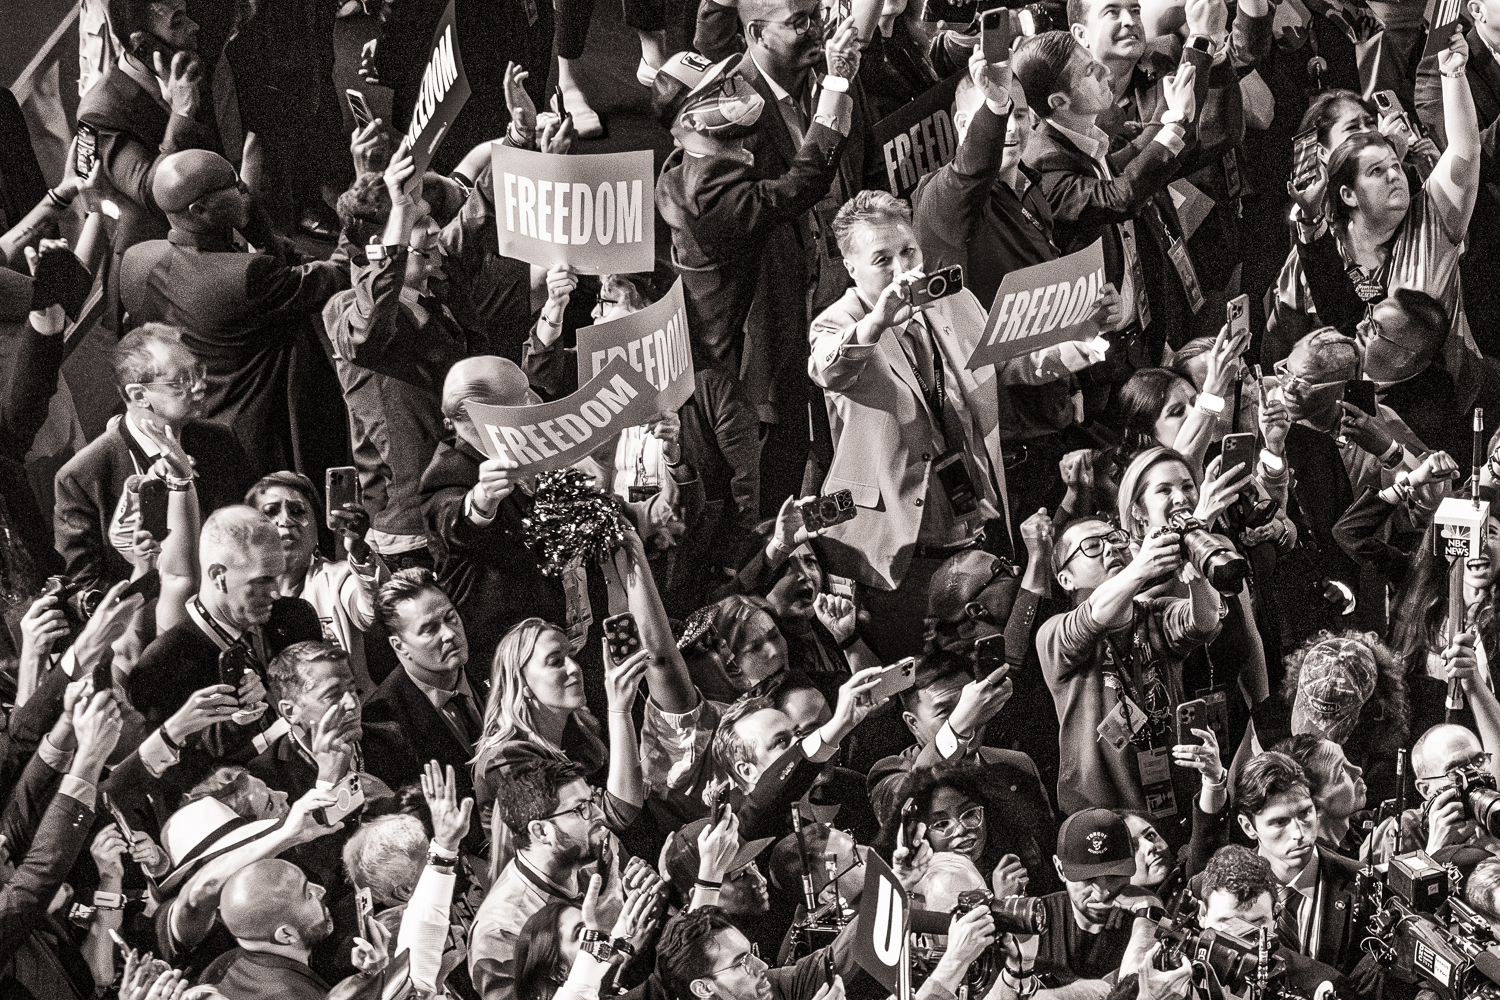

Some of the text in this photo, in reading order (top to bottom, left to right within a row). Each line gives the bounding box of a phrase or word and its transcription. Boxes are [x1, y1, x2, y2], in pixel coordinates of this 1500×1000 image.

[503, 172, 643, 246] FREEDOM
[484, 374, 639, 465] FREEDOM
[1445, 547, 1469, 557] NEWS
[1448, 539, 1467, 548] NBC
